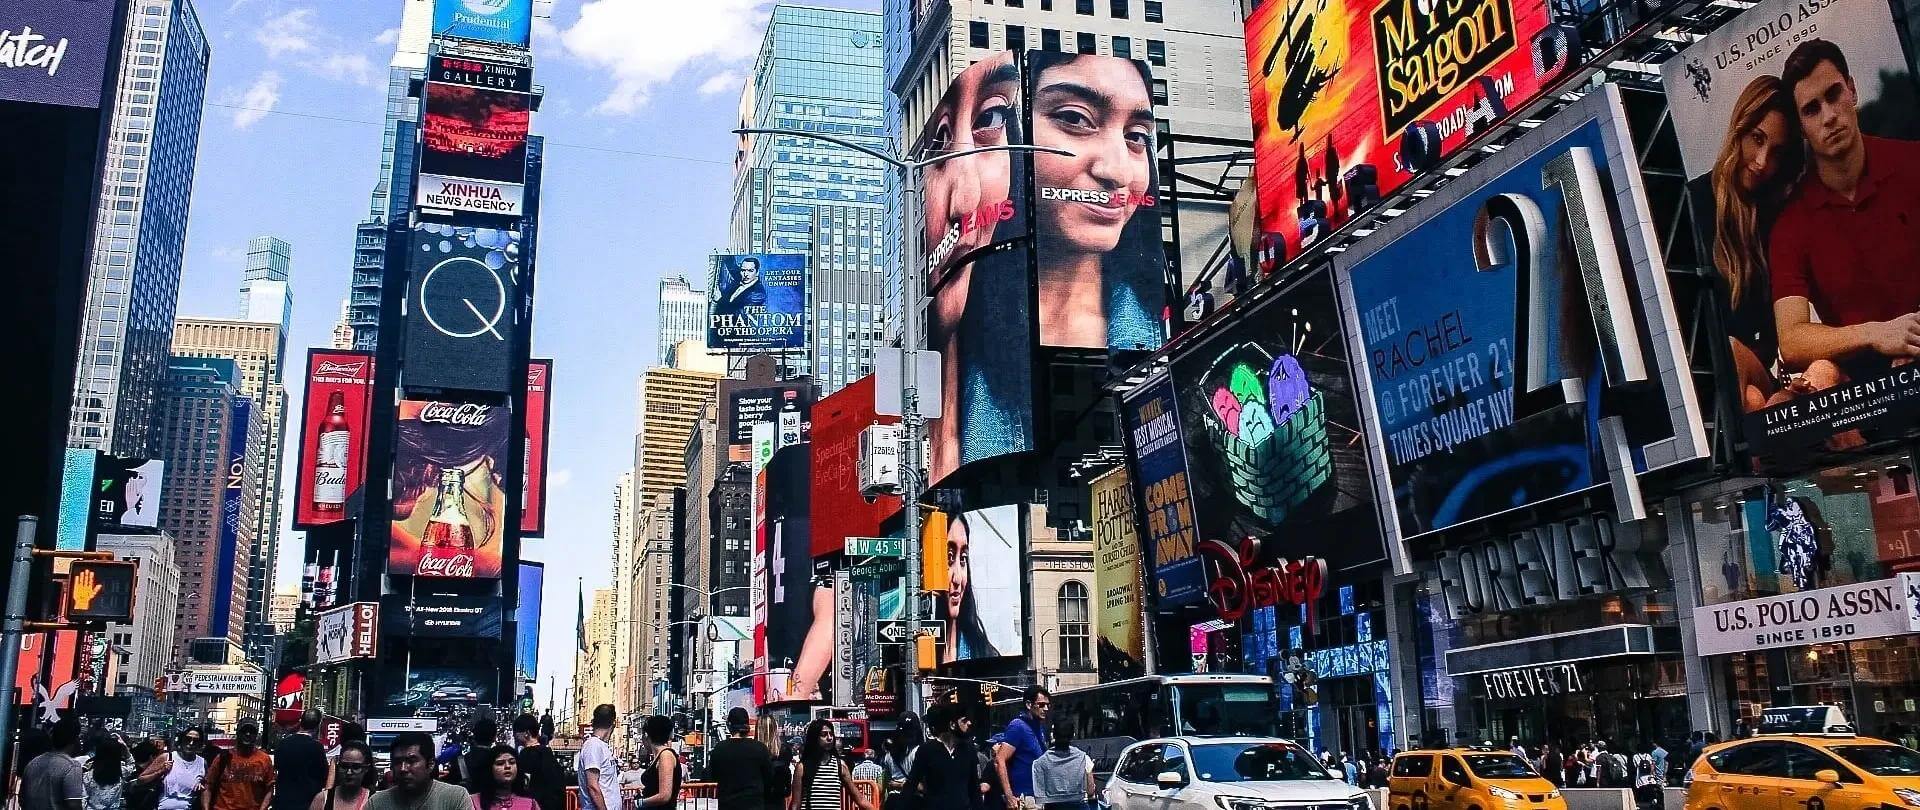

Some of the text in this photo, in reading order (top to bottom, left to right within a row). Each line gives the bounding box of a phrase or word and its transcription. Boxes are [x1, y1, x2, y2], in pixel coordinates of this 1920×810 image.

[455, 12, 511, 29] Prudential
[0, 26, 68, 77] atch
[1714, 42, 1745, 70] U.S.
[1746, 13, 1793, 52] POLO
[1746, 24, 1818, 71] SINCE 1890
[1388, 0, 1506, 116] Saigon
[443, 71, 516, 88] GALLERY
[485, 65, 517, 76] XINHUA
[441, 182, 502, 200] XINHUA
[1041, 187, 1156, 207] EXPRESS JEANS
[426, 194, 515, 212] NEWS AGENCY
[928, 199, 1016, 274] EXPRESS JEANS
[420, 256, 505, 342] Q
[743, 305, 769, 314] THE
[709, 312, 803, 329] PHANTOM
[1365, 296, 1401, 345] MEET
[717, 326, 794, 336] OF THE OPERA
[1373, 309, 1472, 382] RACHEL
[1398, 352, 1484, 416] FOREVER
[1488, 338, 1513, 379] 21
[738, 405, 756, 413] taste
[757, 397, 773, 405] your
[420, 401, 491, 426] Coca-Cola
[743, 412, 764, 420] berry
[1765, 405, 1800, 425] LIVE
[1767, 422, 1793, 437] PAMELA
[1794, 412, 1831, 429] FLANAGAN
[1840, 402, 1866, 416] JONNY
[1868, 394, 1895, 408] LAVINE
[738, 420, 754, 429] good
[1133, 410, 1176, 448] BEST MUSICAL
[1390, 421, 1432, 466] TIMES
[1431, 398, 1490, 454] SQUARE
[1145, 472, 1188, 512] COME
[859, 540, 870, 554] W
[875, 540, 889, 554] 45
[1156, 527, 1194, 567] AWAY
[418, 552, 474, 577] Coca-Cola
[1049, 560, 1067, 569] THE
[1102, 550, 1120, 565] CURSED
[1435, 511, 1650, 618] FOREVER
[851, 565, 877, 577] George
[1106, 583, 1134, 599] BROADWAY
[1106, 597, 1124, 609] SPRING
[1713, 586, 1901, 633] U.S. POLO ASSN.
[358, 604, 374, 655] HELLO!
[886, 627, 906, 637] ONE
[1755, 623, 1856, 645] SINCE 1890
[194, 674, 227, 682] PEDESTRIAN
[236, 683, 257, 691] MOVING
[1483, 663, 1583, 700] FOREVER 21
